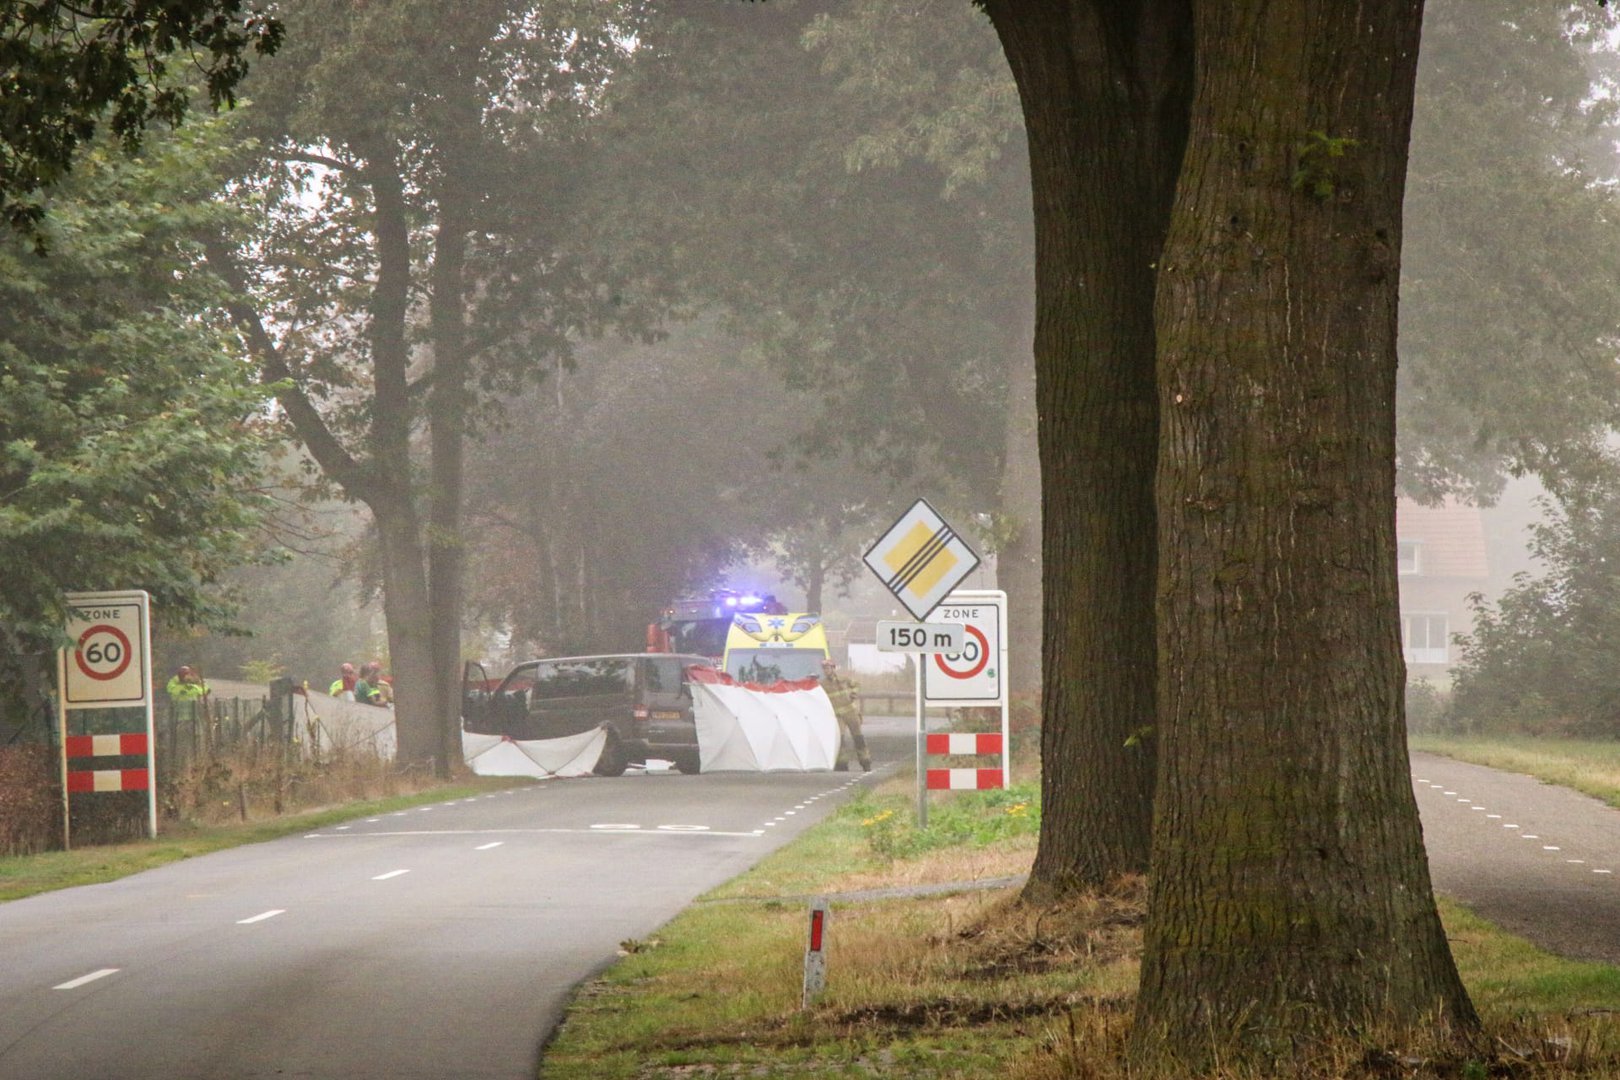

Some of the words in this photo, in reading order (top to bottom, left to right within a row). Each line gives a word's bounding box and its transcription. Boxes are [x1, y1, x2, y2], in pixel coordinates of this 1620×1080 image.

[84, 609, 121, 619] ZONE
[943, 609, 979, 618] ZONE
[890, 628, 926, 647] 150
[934, 633, 951, 647] m
[86, 642, 121, 663] 60
